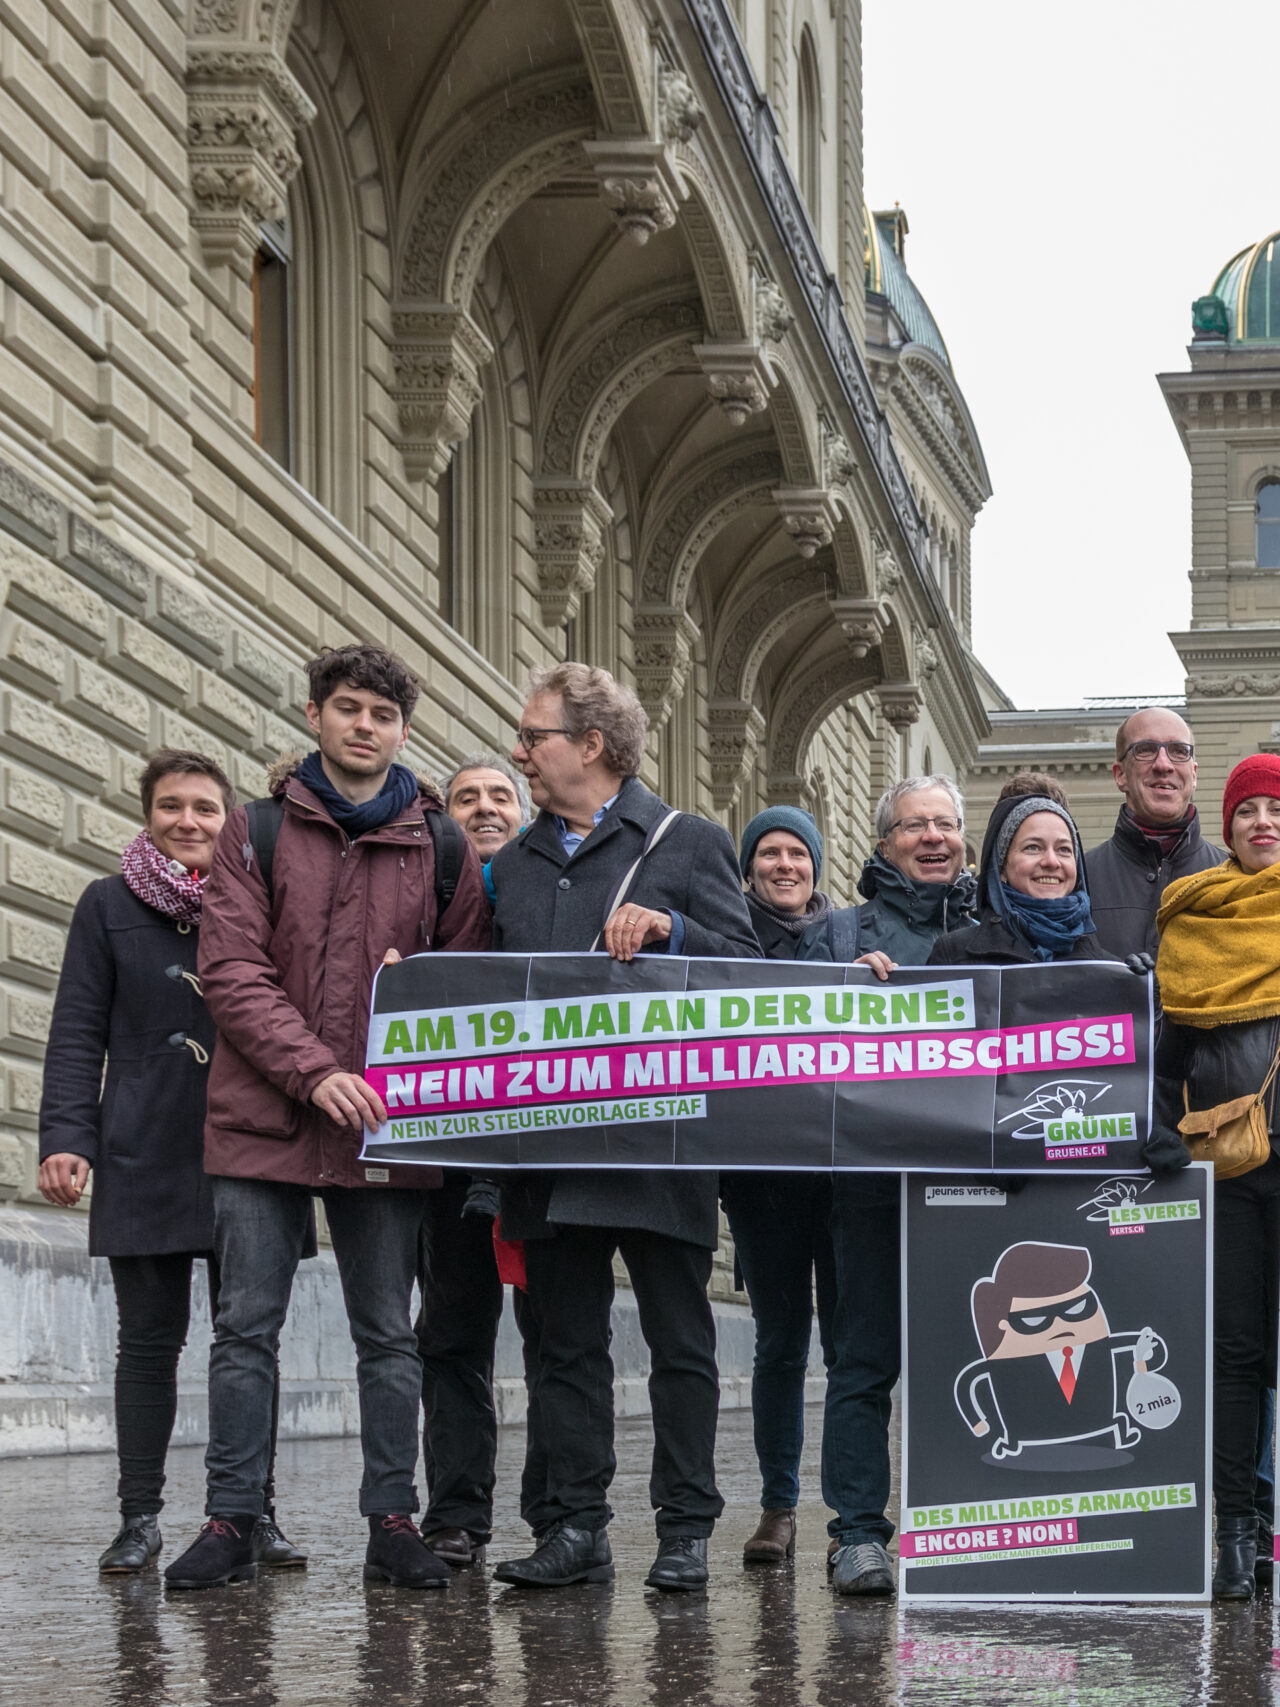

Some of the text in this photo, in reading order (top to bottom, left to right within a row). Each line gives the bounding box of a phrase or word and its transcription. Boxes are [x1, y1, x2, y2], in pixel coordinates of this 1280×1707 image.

[383, 989, 966, 1055] AM 19. MAI AN DER URNE:
[386, 1022, 1126, 1108] NEIN ZUM MILLIARDENBSCHISS!
[391, 1097, 701, 1139] NEIN ZUR STEUERVORLAGE STAF
[1047, 1115, 1133, 1142] GRÜNE
[1047, 1146, 1106, 1159] GRUENE.CH
[1111, 1203, 1198, 1223] LES VERTS
[1110, 1225, 1144, 1235] VERTS.CH
[1136, 1395, 1176, 1415] 2 mia.
[913, 1485, 1192, 1528] DES MILLIARDS ARNAQUÉS
[915, 1529, 999, 1553] ENCORE
[1017, 1523, 1062, 1544] NON
[915, 1556, 945, 1567] PROJET
[946, 1554, 973, 1564] FISCAL
[978, 1551, 1008, 1561] SIGNEZ
[1010, 1546, 1063, 1559] MAINTENANT
[1064, 1545, 1074, 1554] LE
